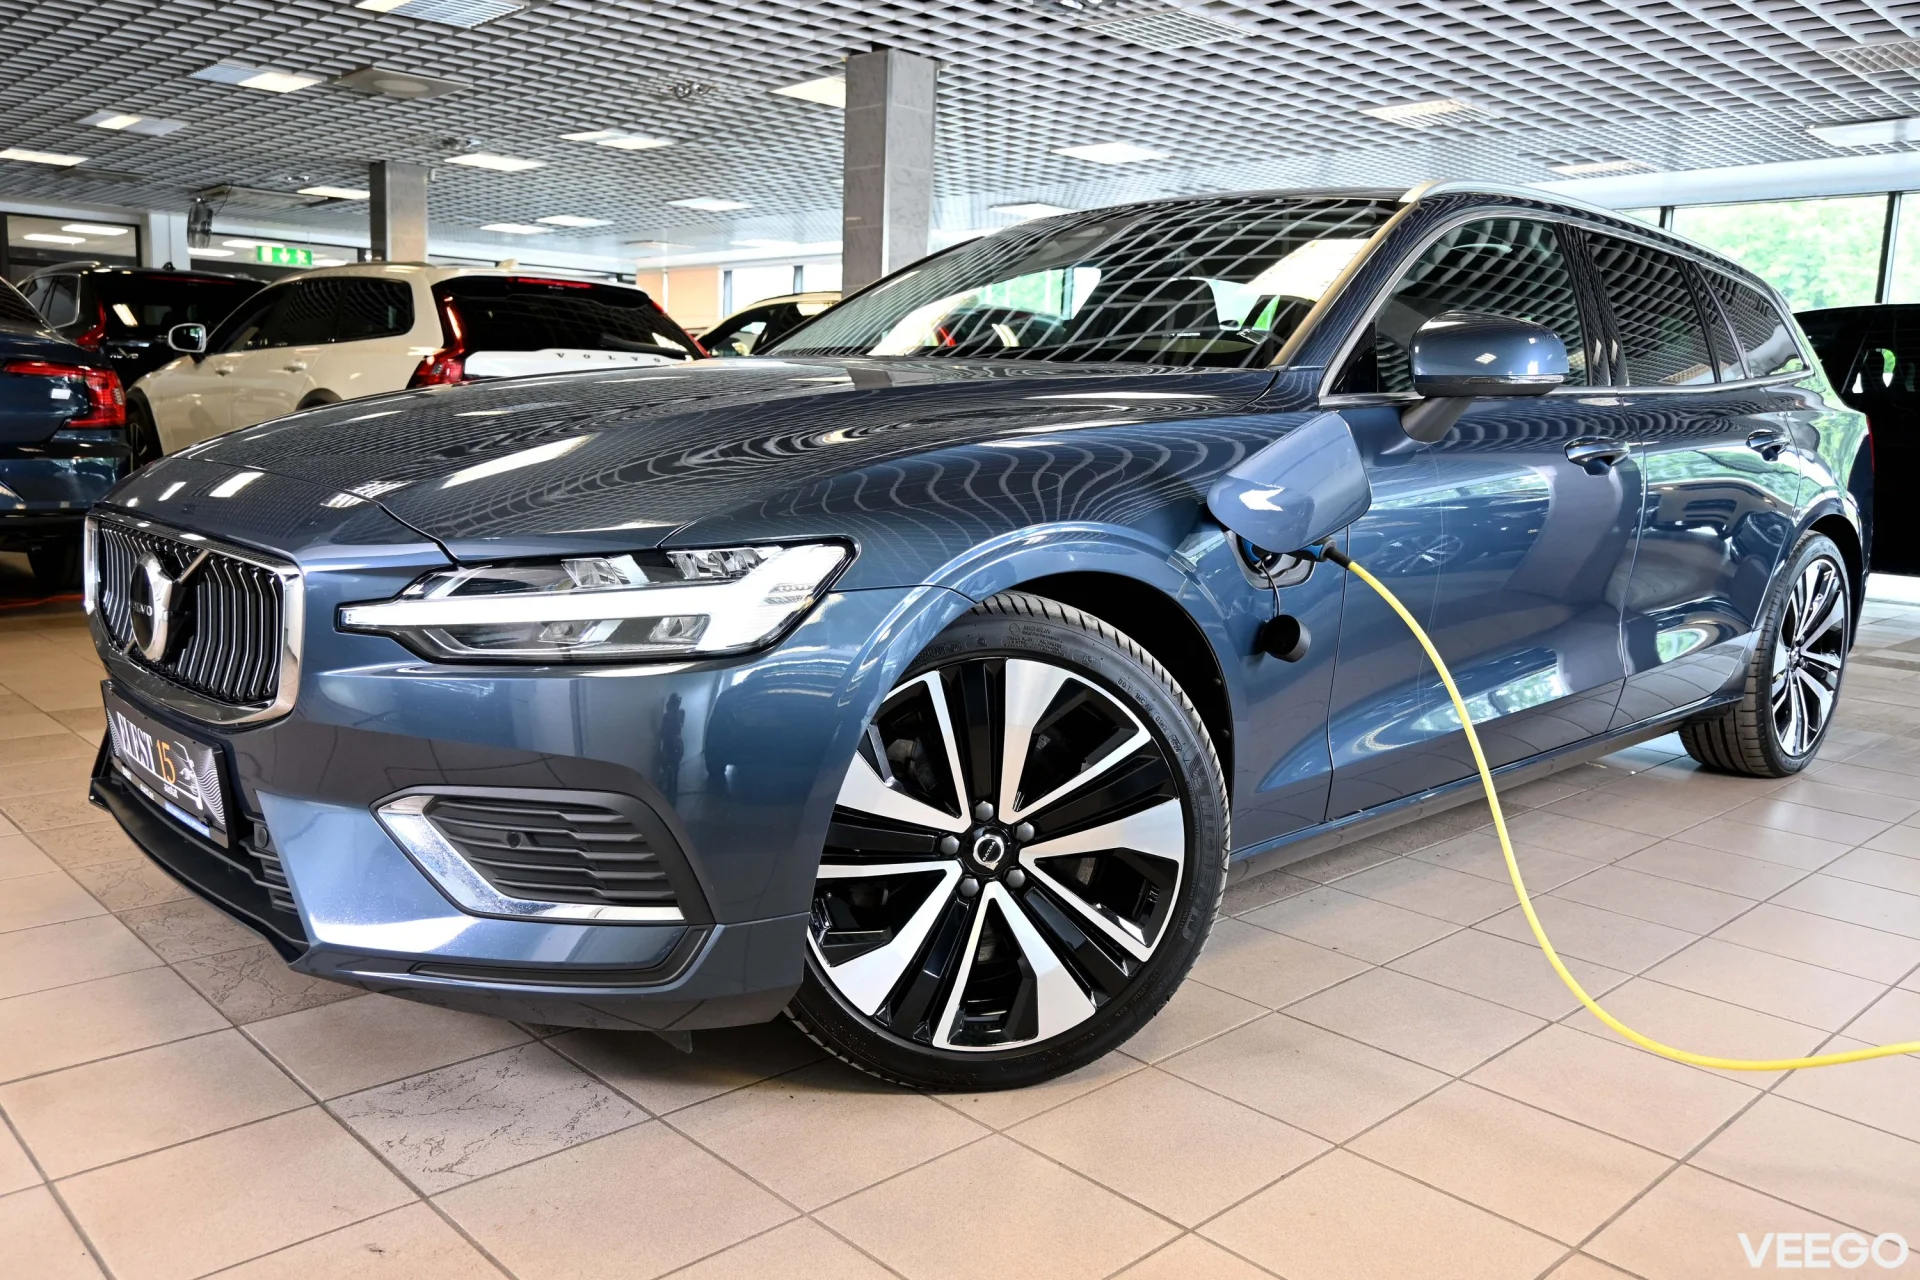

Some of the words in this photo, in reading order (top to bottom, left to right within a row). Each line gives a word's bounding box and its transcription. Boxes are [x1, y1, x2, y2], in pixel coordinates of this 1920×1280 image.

[555, 352, 661, 363] VOLVO
[130, 598, 153, 617] OLVO
[156, 739, 176, 784] 15
[1181, 792, 1216, 944] MICHELIN
